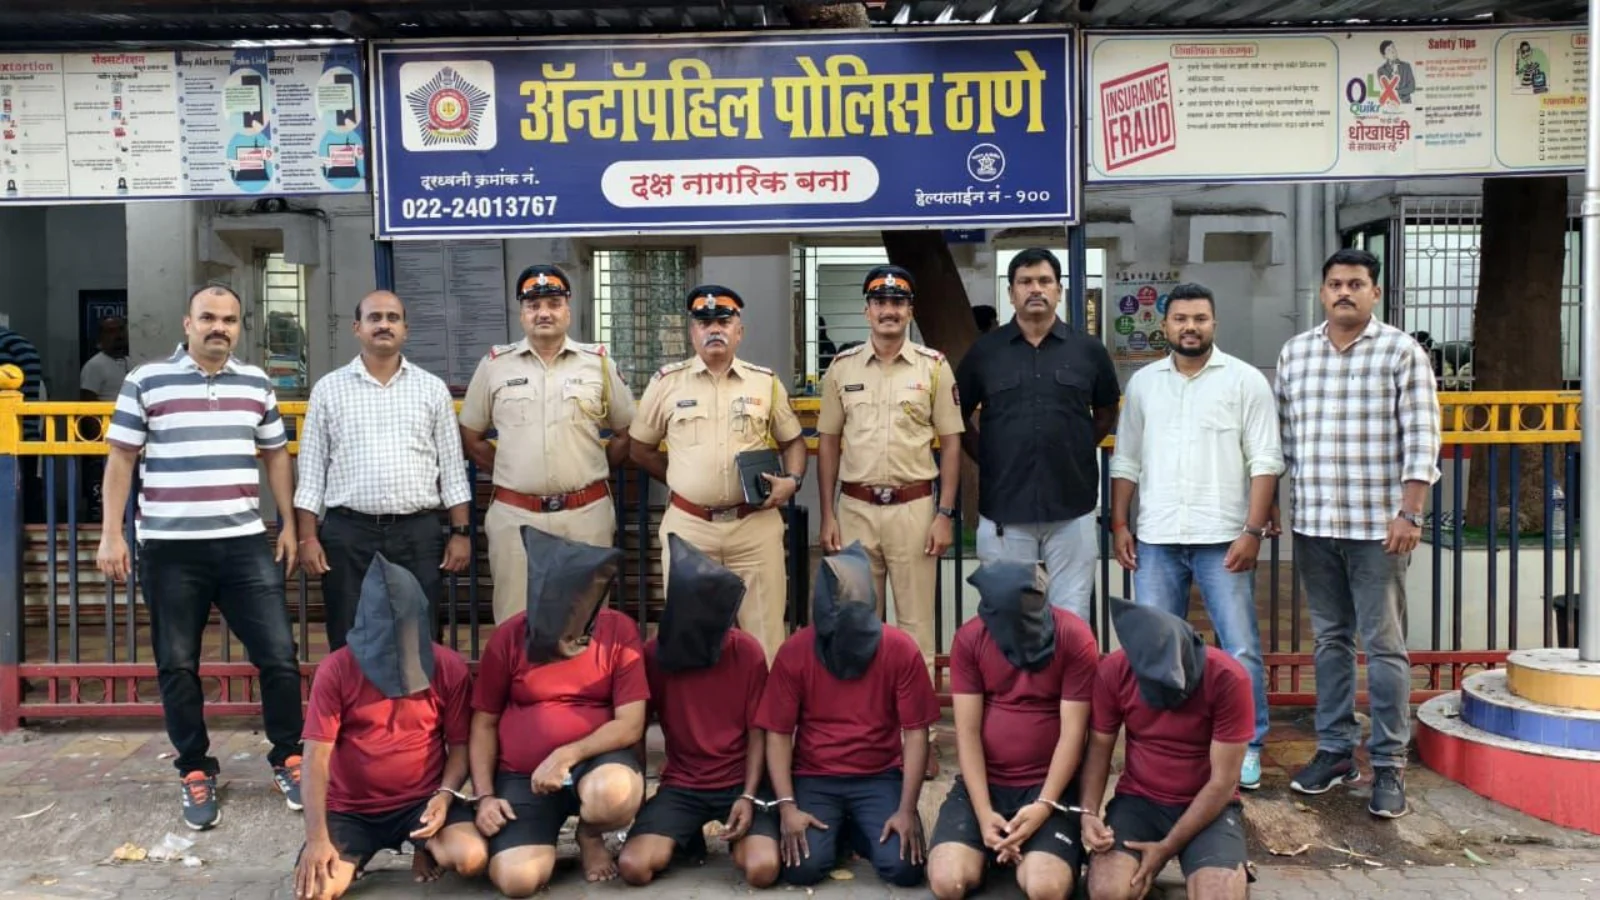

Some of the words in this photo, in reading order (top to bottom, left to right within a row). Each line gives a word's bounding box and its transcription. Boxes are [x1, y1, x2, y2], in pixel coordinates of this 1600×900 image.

[1428, 37, 1456, 50] Safety
[1458, 37, 1476, 50] Tips
[0, 61, 54, 71] xtortion
[771, 54, 934, 138] पोलिस
[942, 50, 1046, 133] ठाणे
[1106, 74, 1168, 117] INSURANCE
[1346, 73, 1400, 105] OLX
[1350, 101, 1380, 116] Quikr
[1108, 101, 1171, 160] FRAUD
[420, 171, 471, 190] दूरध्वनी
[474, 167, 519, 189] क्रमांक
[630, 173, 674, 200] दक्ष
[681, 165, 788, 195] नागरिक
[795, 170, 850, 192] बना
[402, 195, 558, 219] 022-24013767
